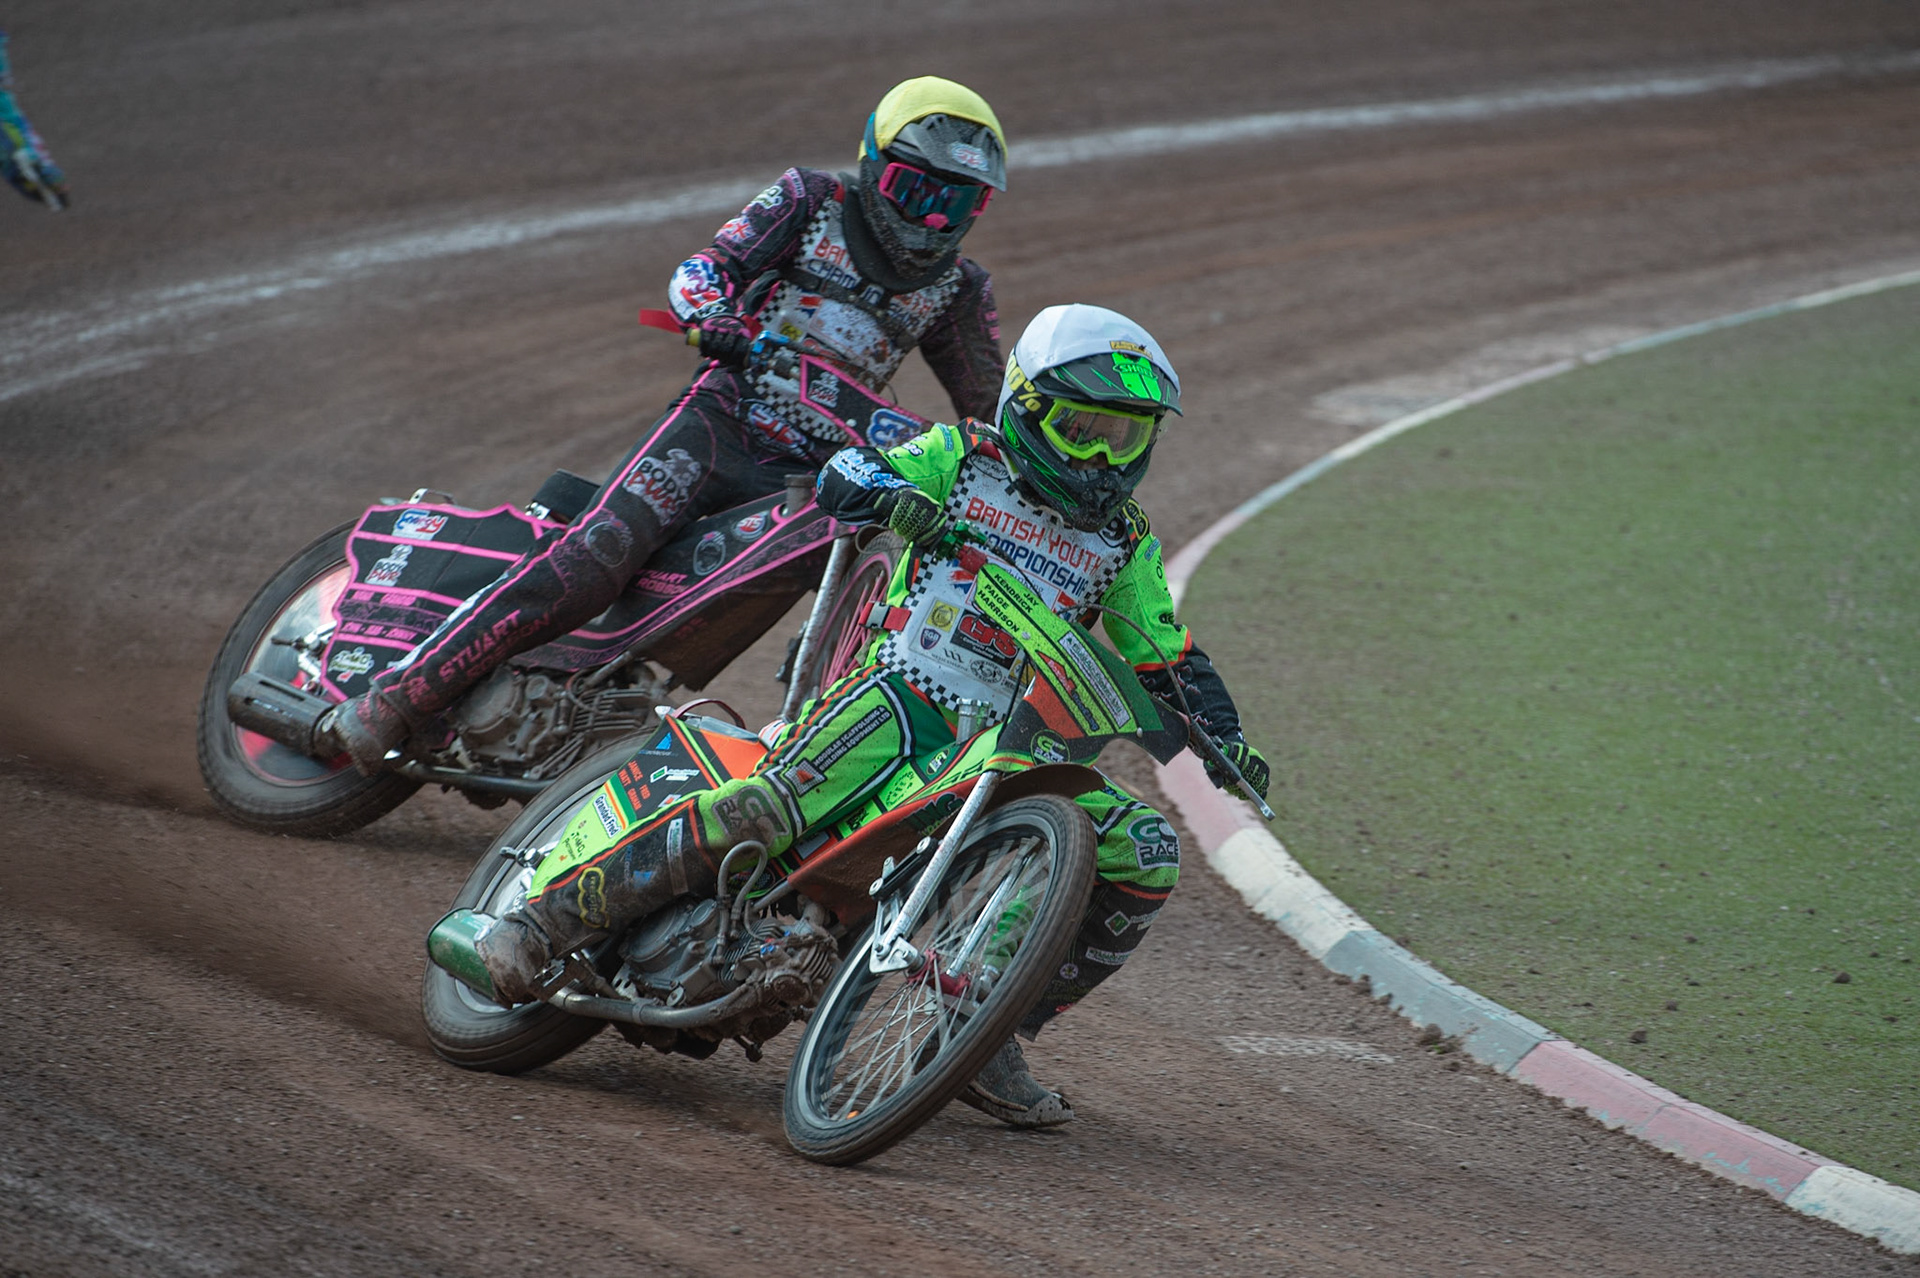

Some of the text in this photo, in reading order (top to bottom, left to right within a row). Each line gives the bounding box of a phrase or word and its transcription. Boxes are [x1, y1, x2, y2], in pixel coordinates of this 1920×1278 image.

[965, 497, 1045, 547] BRITISH
[638, 568, 688, 584] TUART
[994, 573, 1033, 613] KENDRICK
[977, 589, 1020, 633] HARRISON
[983, 583, 1009, 610] PAIGE
[1022, 591, 1039, 607] JAY
[438, 608, 522, 679] STUART
[813, 741, 842, 767] MODULAR
[840, 711, 880, 746] SCAFFOLDING
[818, 710, 891, 772] BUILDING EQUIPMENT LTD
[617, 768, 632, 787] WATT
[627, 760, 644, 782] JANICE
[595, 795, 621, 836] Grandad Fred
[1138, 844, 1179, 857] RACE
